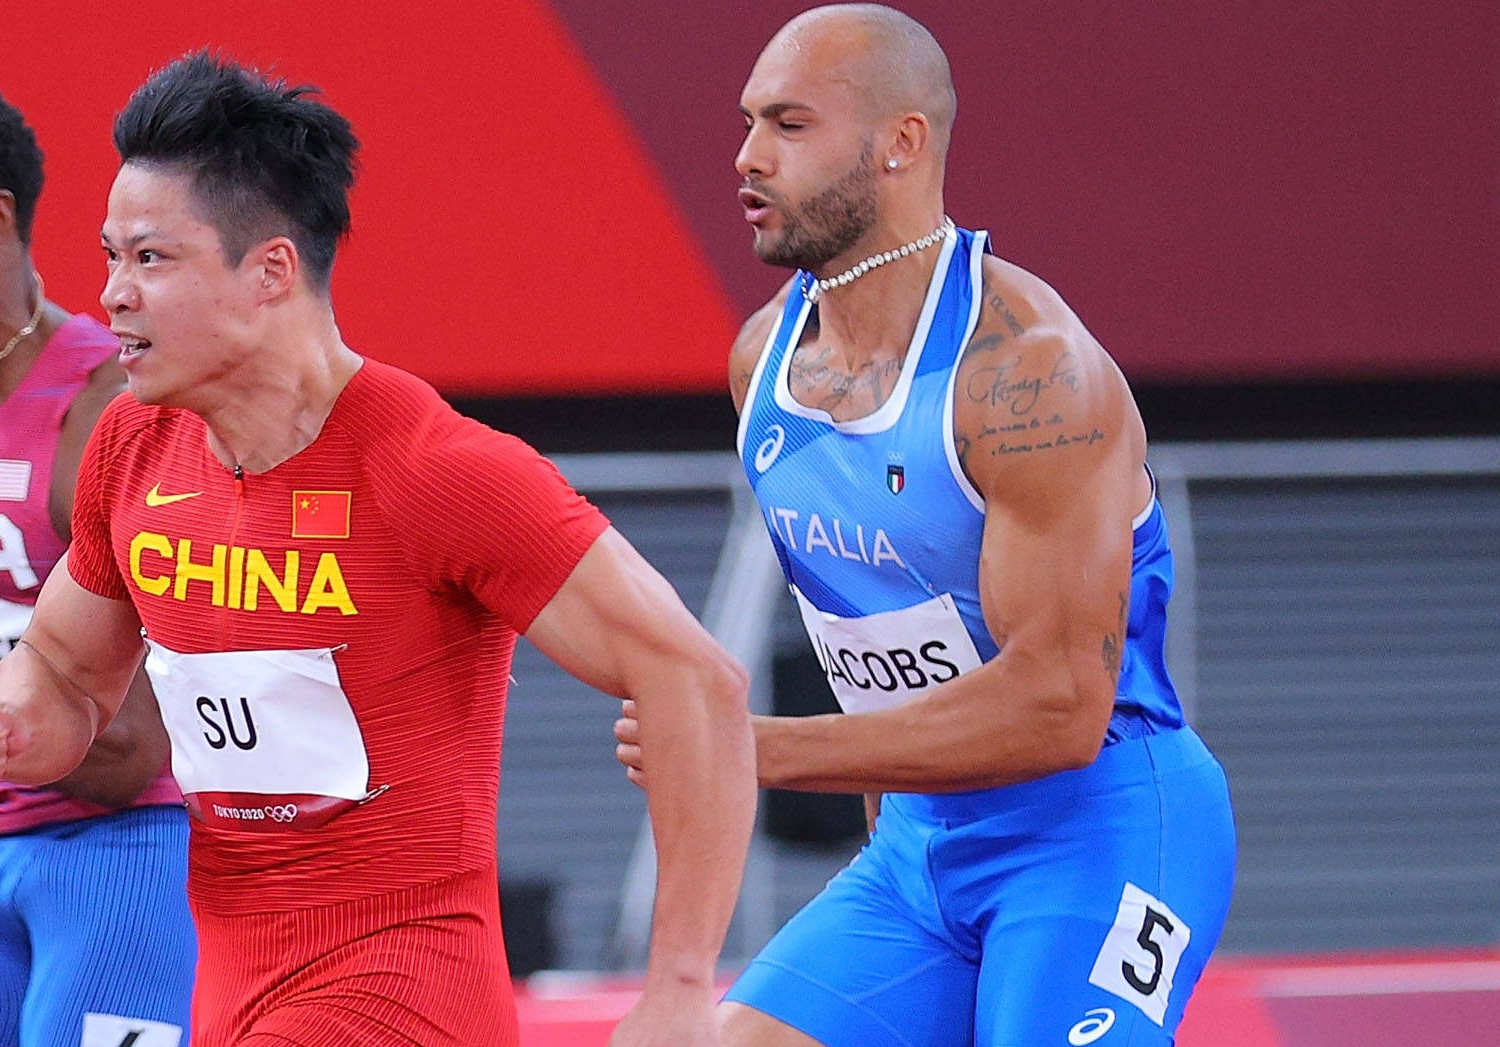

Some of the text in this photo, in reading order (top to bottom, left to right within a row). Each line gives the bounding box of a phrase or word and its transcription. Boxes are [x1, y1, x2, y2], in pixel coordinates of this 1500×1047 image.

[768, 506, 910, 569] ITALIA
[128, 530, 359, 616] CHINA
[195, 696, 259, 751] SU
[212, 803, 266, 820] TOKYO 2020
[1120, 904, 1175, 997] 5
